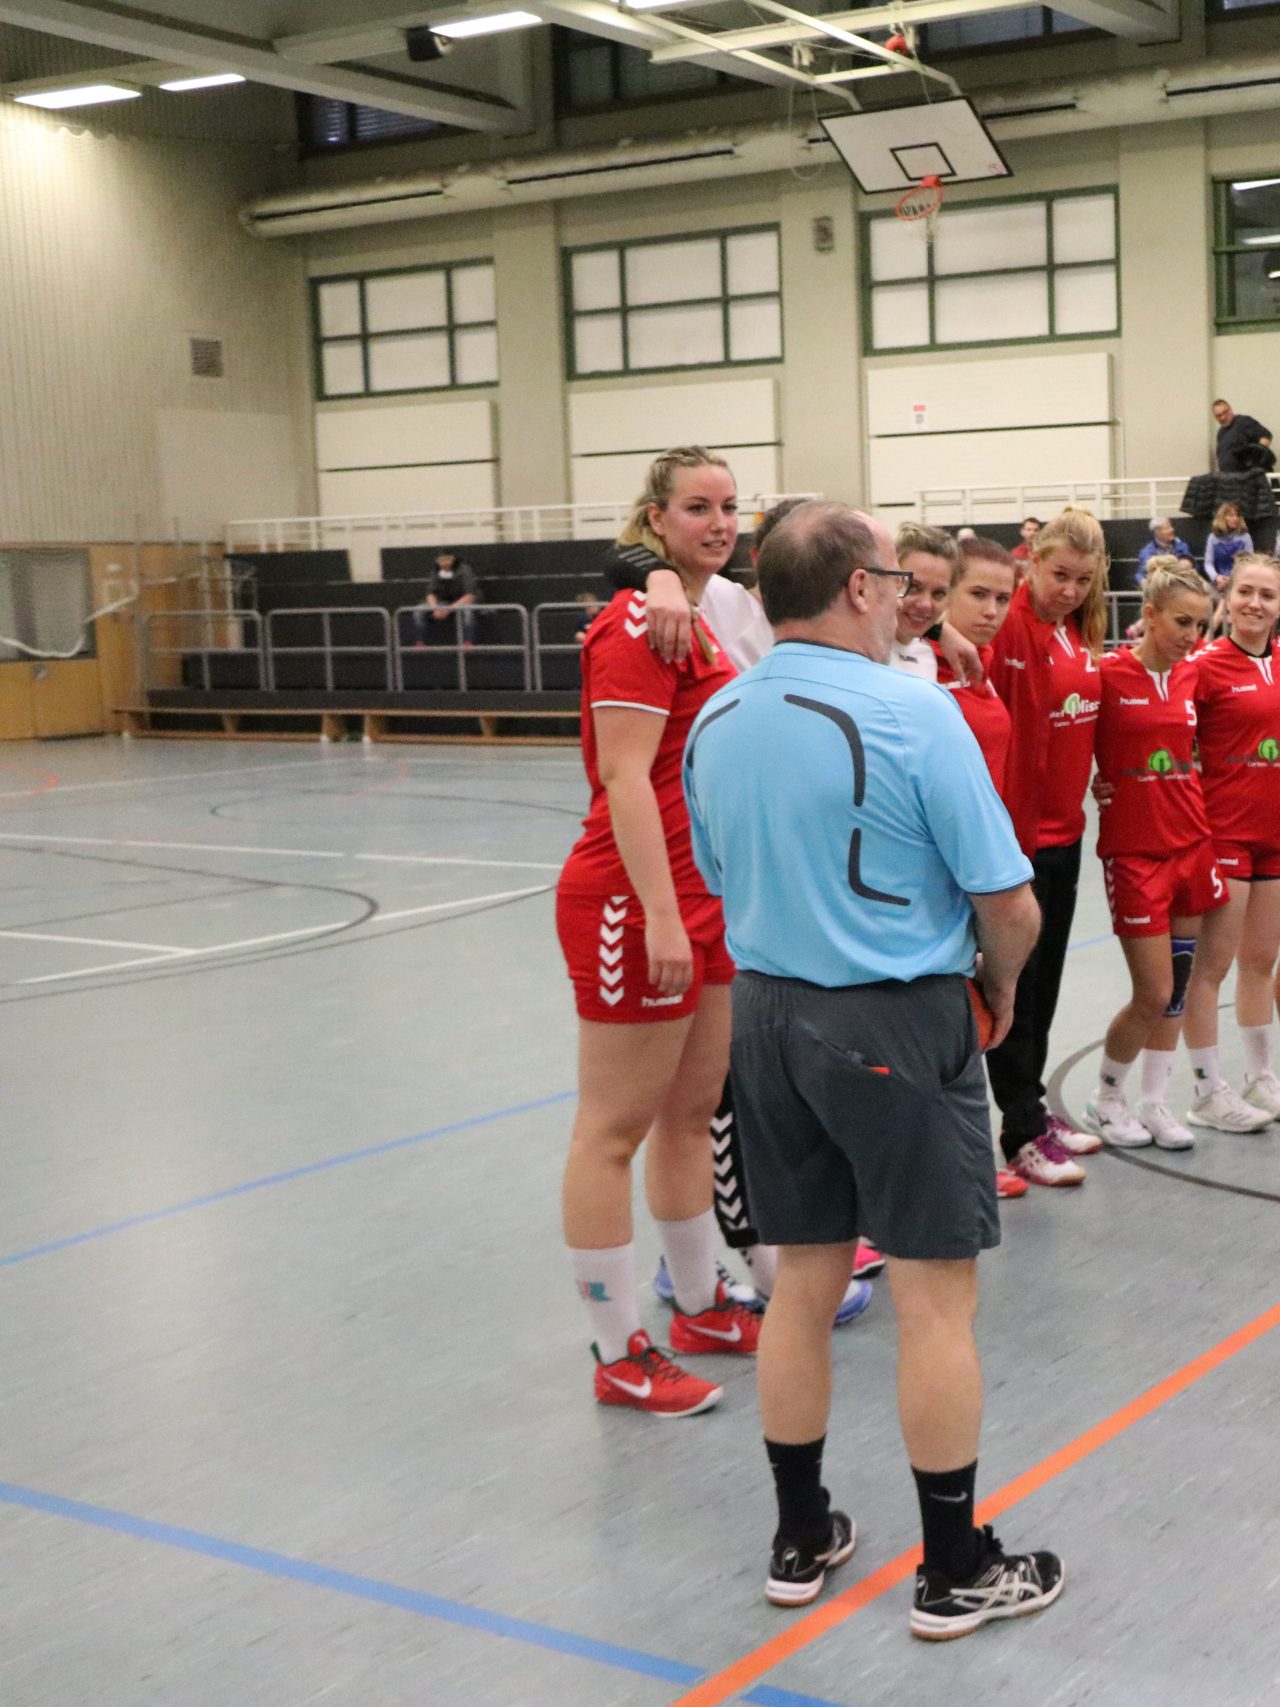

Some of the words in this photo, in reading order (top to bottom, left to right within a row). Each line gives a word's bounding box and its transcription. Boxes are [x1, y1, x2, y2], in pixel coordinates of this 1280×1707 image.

[1231, 683, 1258, 693] hummel
[1120, 697, 1149, 705] hummel
[1184, 699, 1198, 726] 5
[1210, 867, 1223, 899] 5
